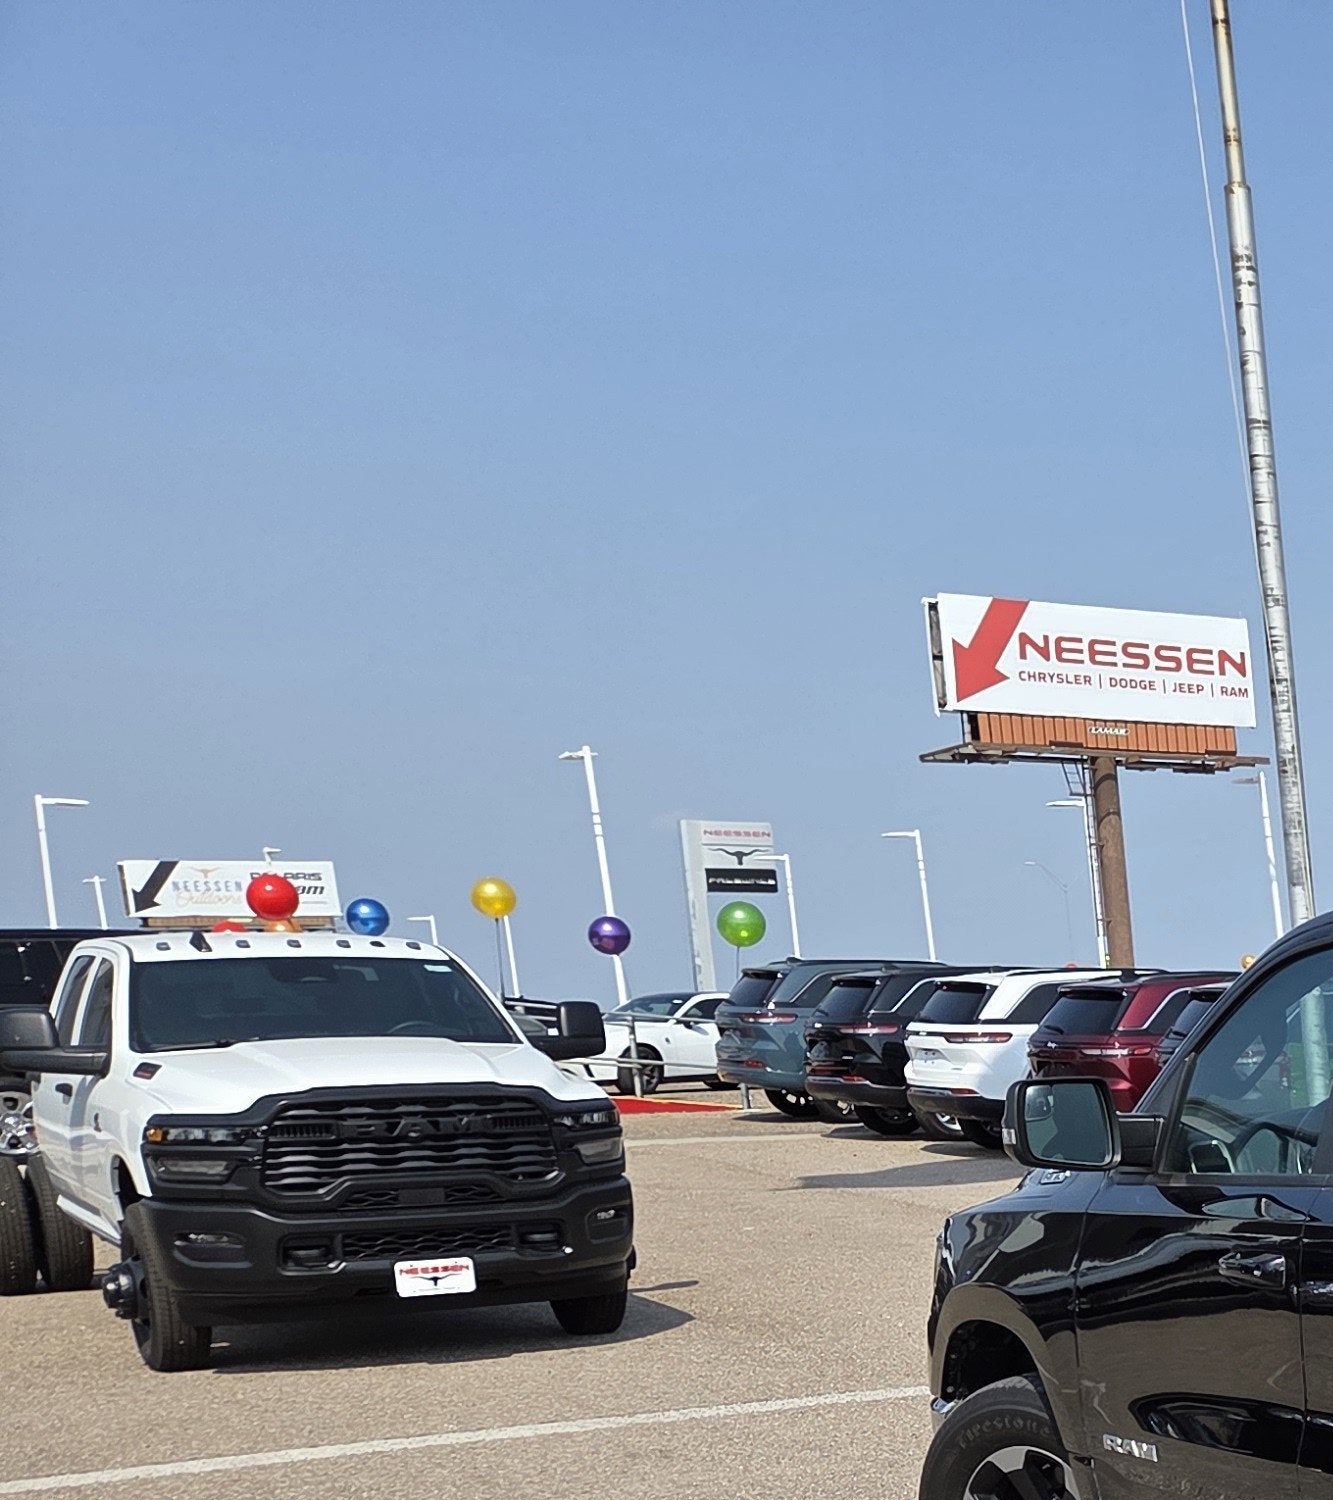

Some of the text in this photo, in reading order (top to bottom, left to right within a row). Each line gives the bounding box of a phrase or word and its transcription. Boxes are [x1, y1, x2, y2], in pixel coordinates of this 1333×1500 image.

[1018, 631, 1246, 678] NEESSEN
[1018, 670, 1249, 698] CHRYSLER DODGE JEEP RAM
[172, 880, 242, 892] NEESSEN
[1102, 1433, 1158, 1463] RAM
